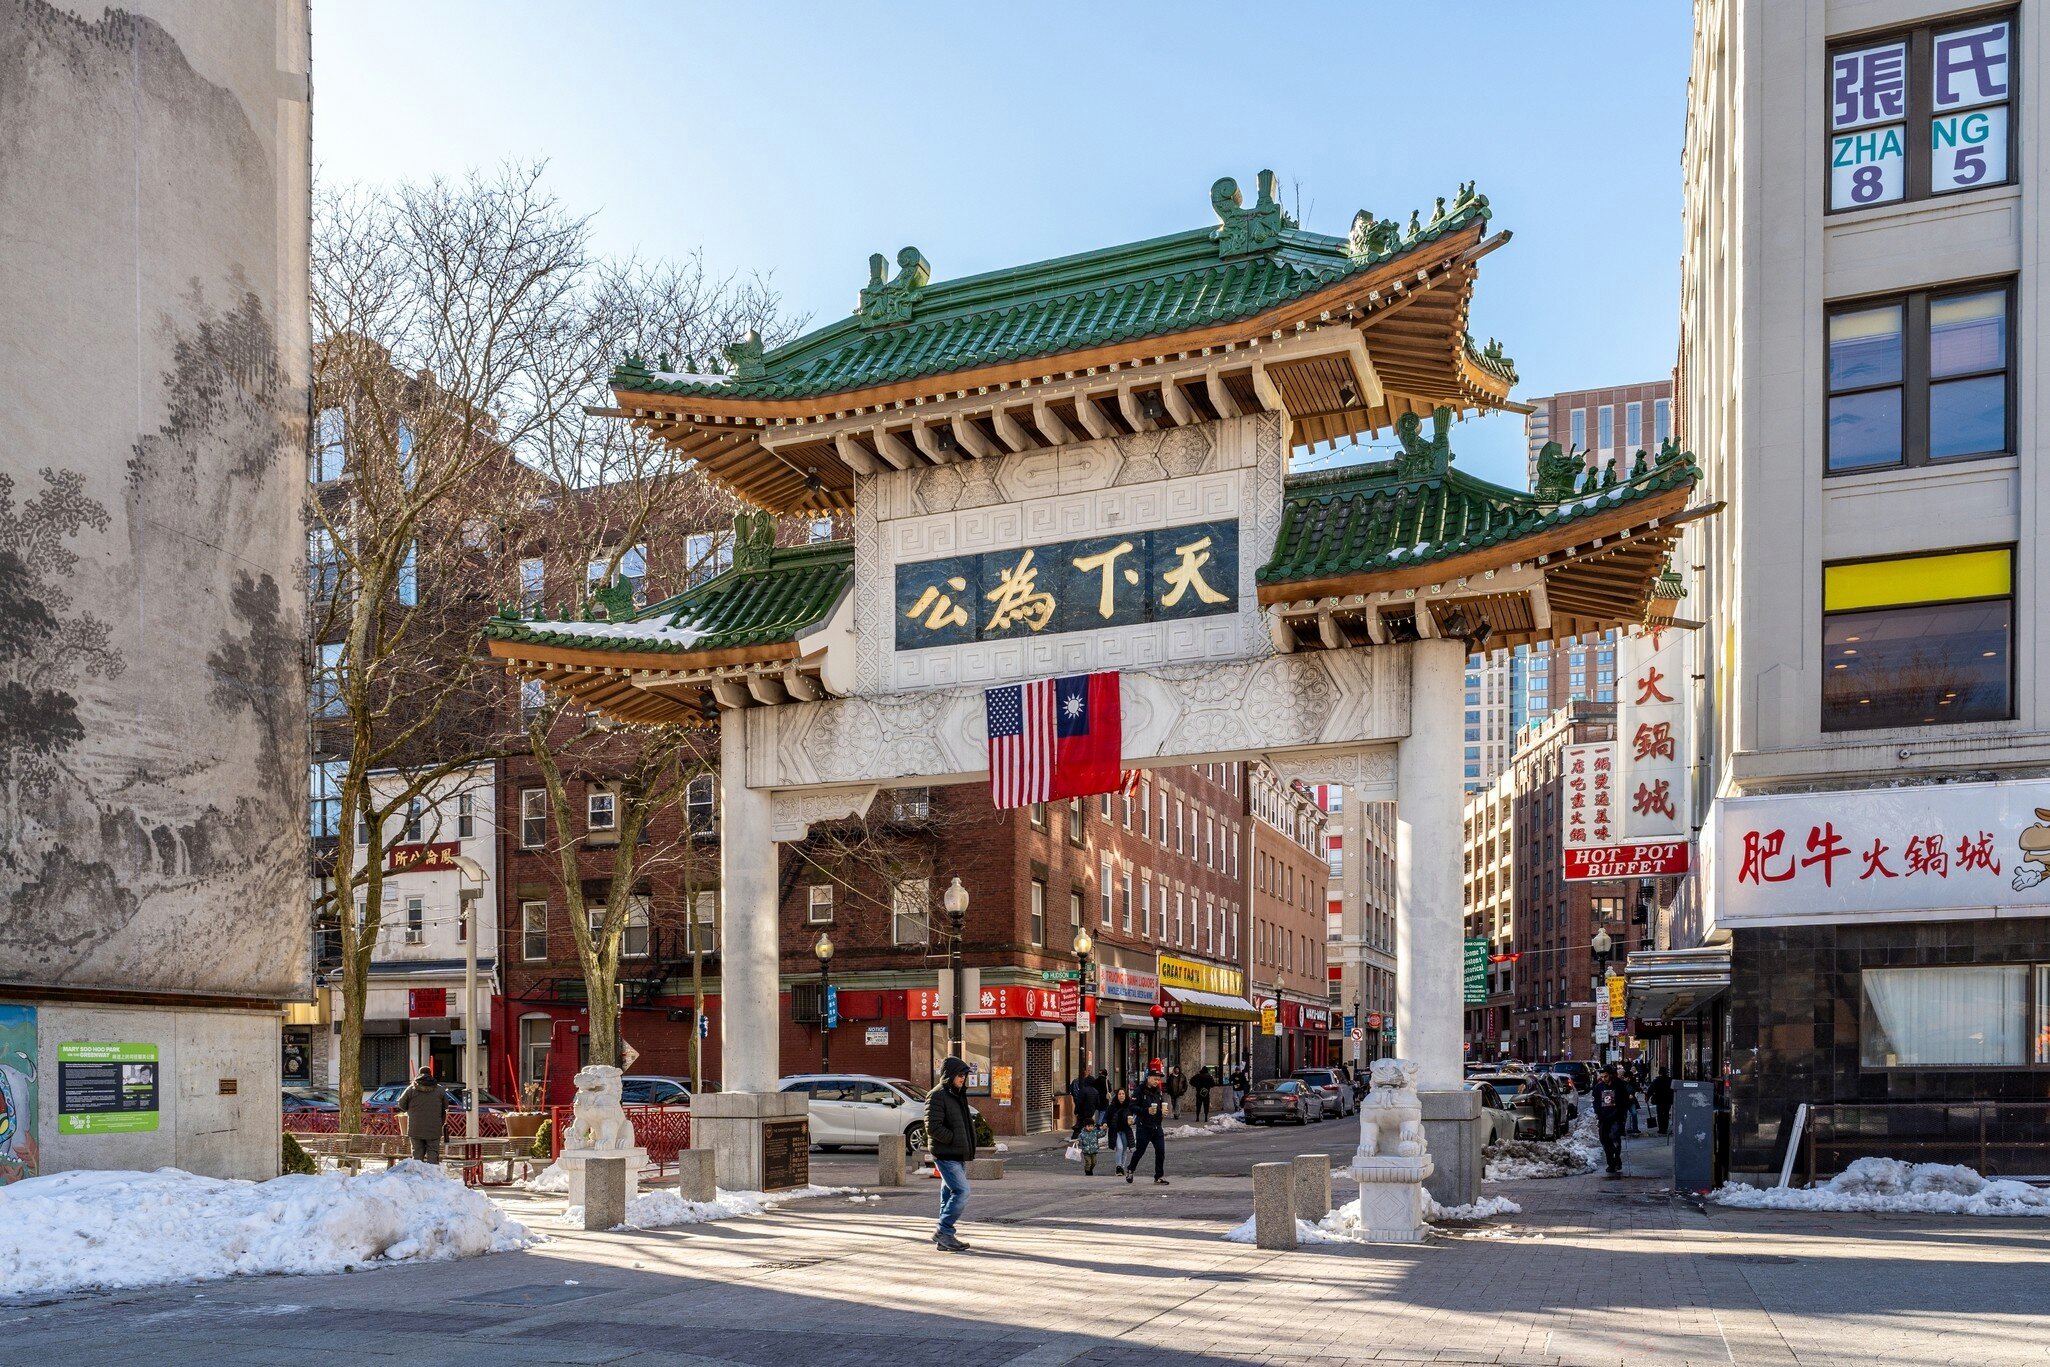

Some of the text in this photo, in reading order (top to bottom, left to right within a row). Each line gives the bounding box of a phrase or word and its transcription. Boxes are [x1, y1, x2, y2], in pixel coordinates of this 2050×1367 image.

[1575, 844, 1679, 864] HOT POT
[1738, 821, 2000, 888] 肥牛火鍋城
[1587, 860, 1666, 877] BUFFET
[1049, 971, 1069, 979] HUDSON
[1162, 963, 1182, 979] GREAT
